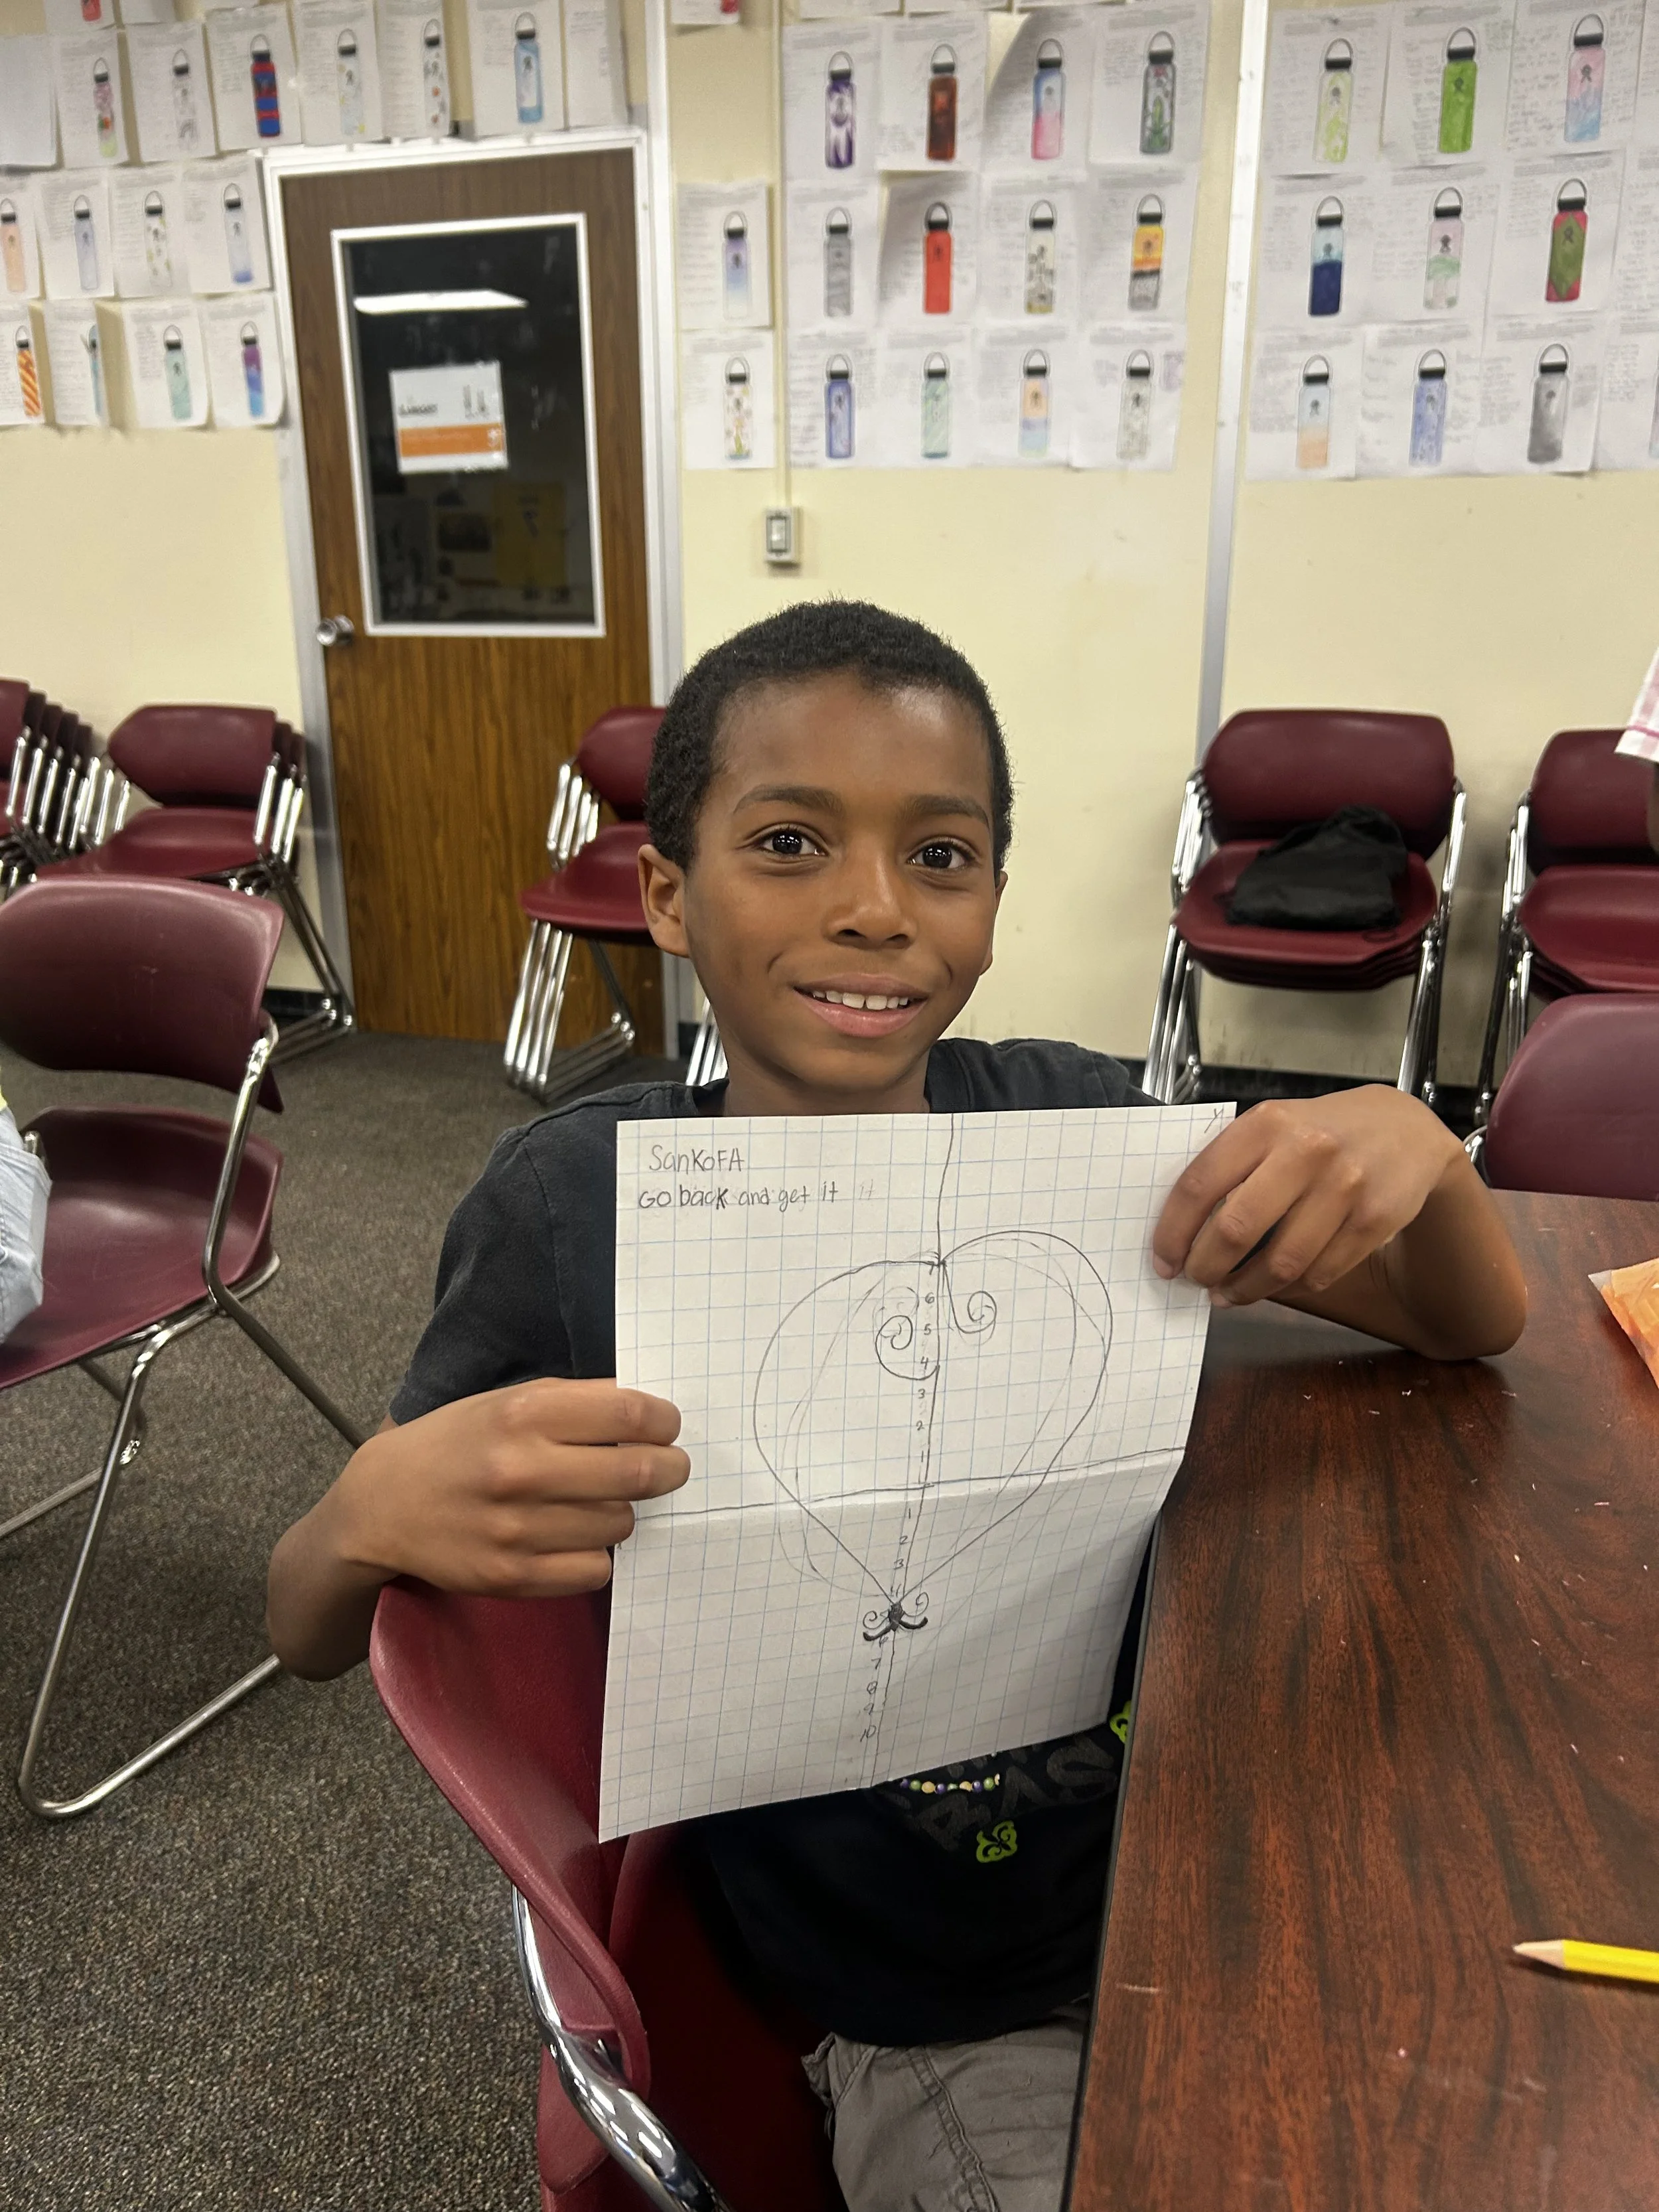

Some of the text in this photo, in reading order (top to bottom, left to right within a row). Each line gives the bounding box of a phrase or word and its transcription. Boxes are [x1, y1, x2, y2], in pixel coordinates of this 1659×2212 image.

[738, 1187, 769, 1206] and
[778, 1185, 810, 1213] get
[822, 1181, 839, 1203] it
[924, 1291, 935, 1304] 6
[923, 1323, 932, 1335] 5
[920, 1356, 929, 1370] 4
[918, 1388, 926, 1399] 3
[916, 1420, 925, 1431] 2
[899, 1535, 908, 1546] 2
[893, 1558, 904, 1570] 3
[871, 1657, 882, 1670] 7
